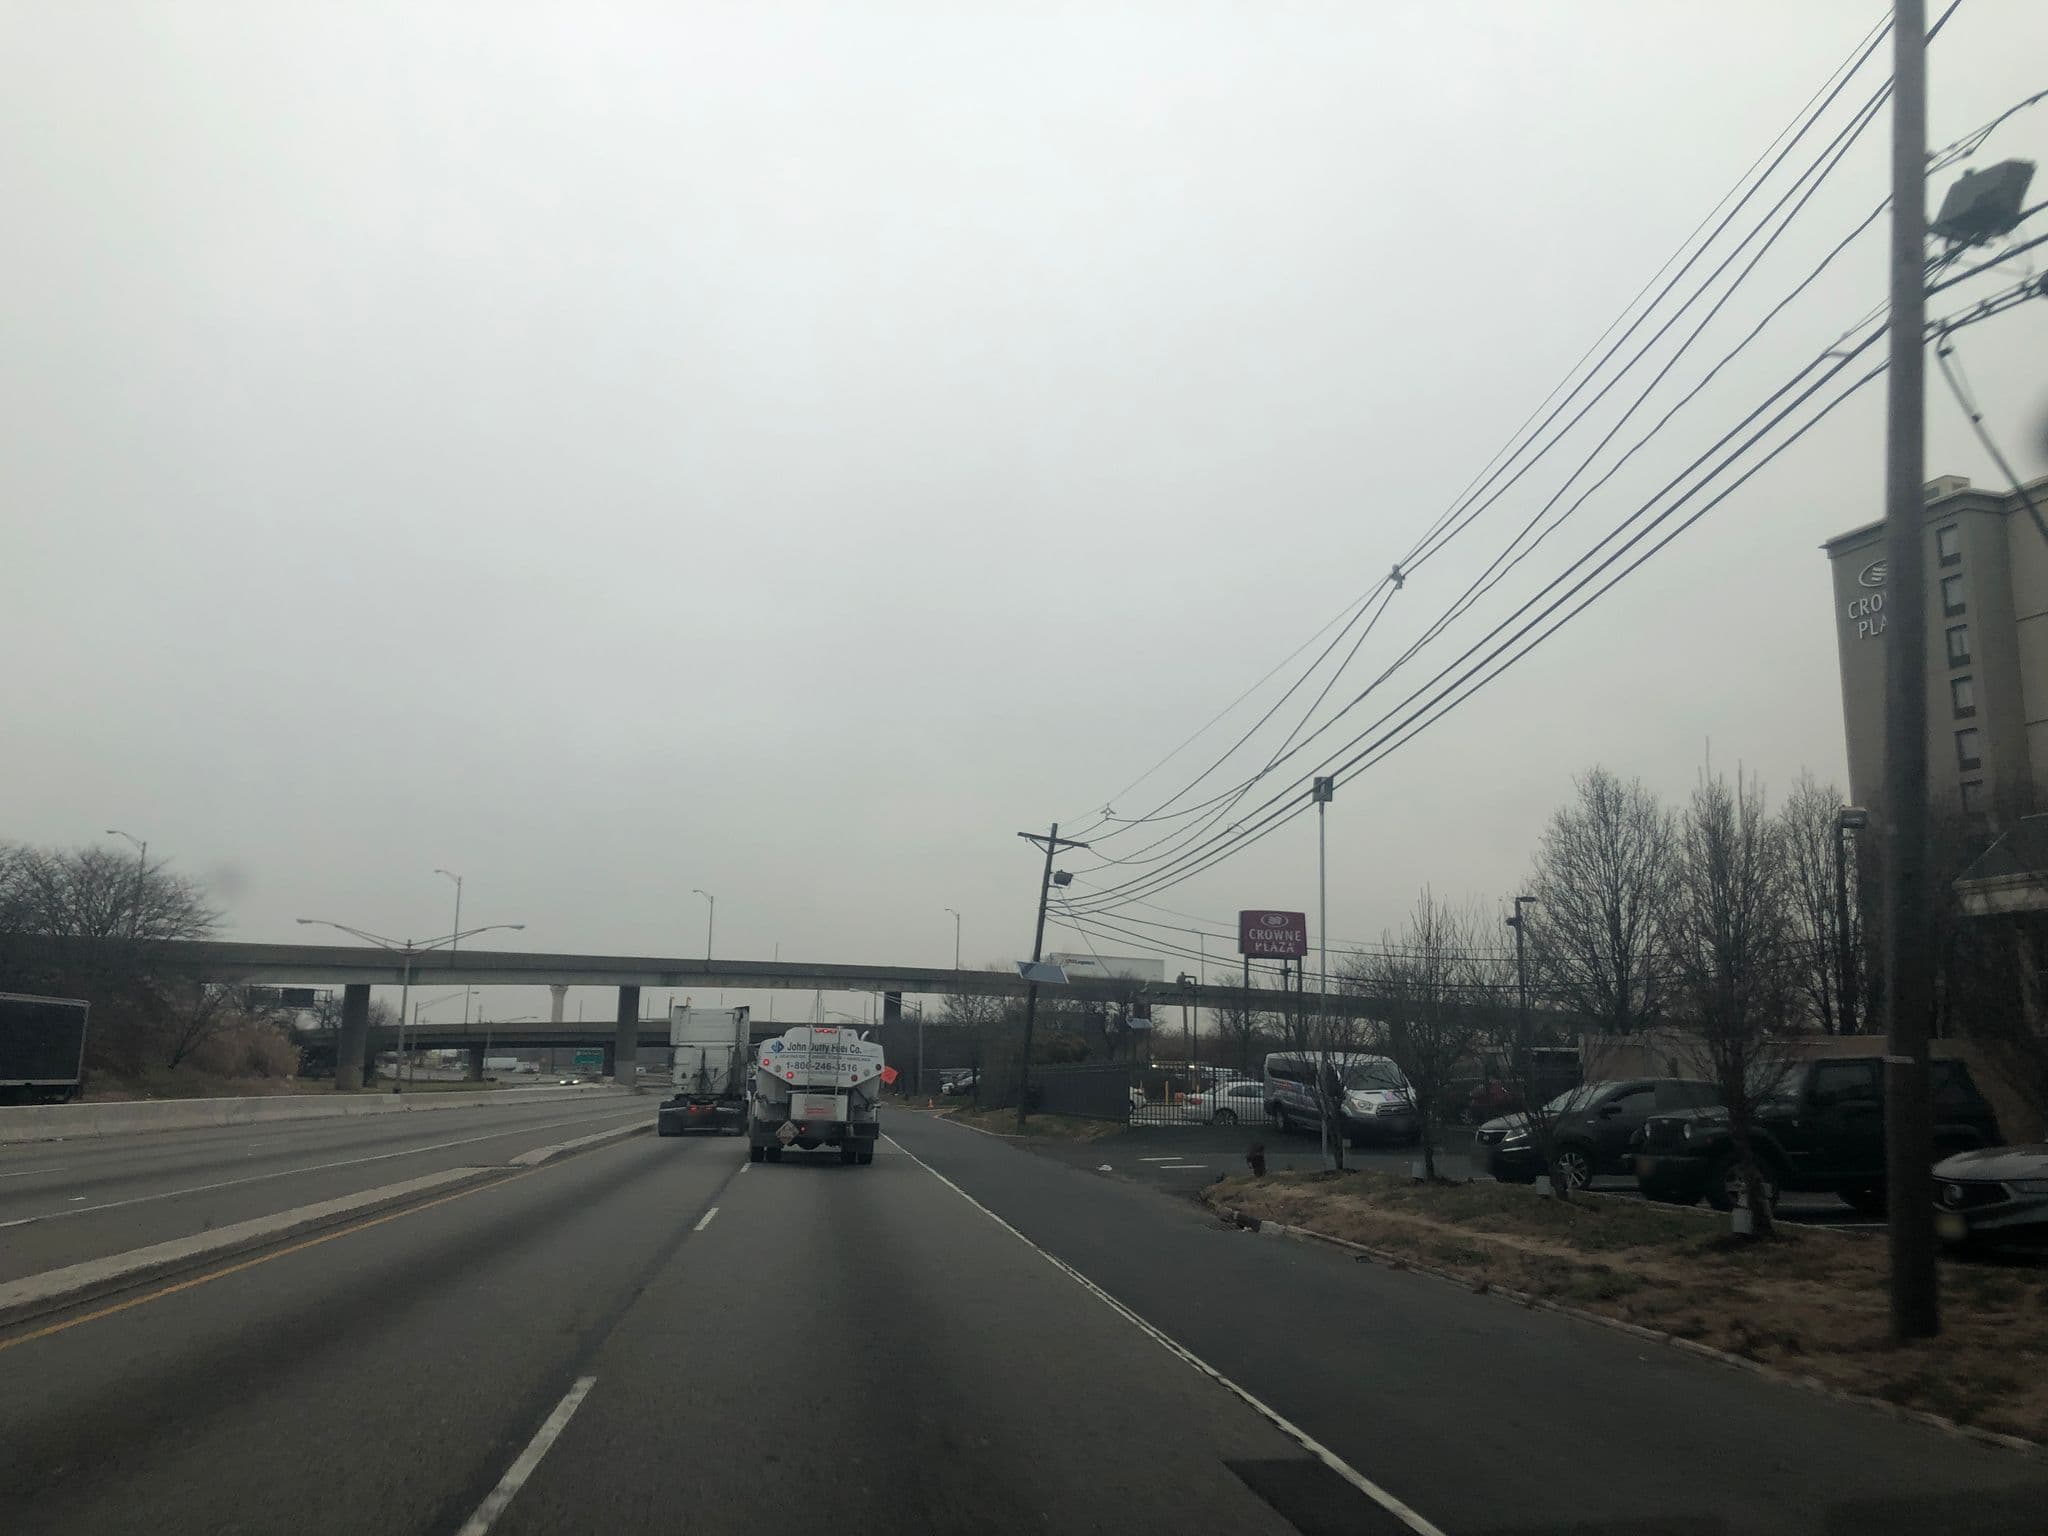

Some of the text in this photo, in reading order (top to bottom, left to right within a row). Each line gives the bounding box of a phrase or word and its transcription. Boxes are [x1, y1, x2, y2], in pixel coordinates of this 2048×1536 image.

[1248, 928, 1302, 942] CROWNE
[1255, 941, 1295, 953] PLAZA
[787, 1042, 807, 1052] John
[849, 1044, 862, 1055] Co.
